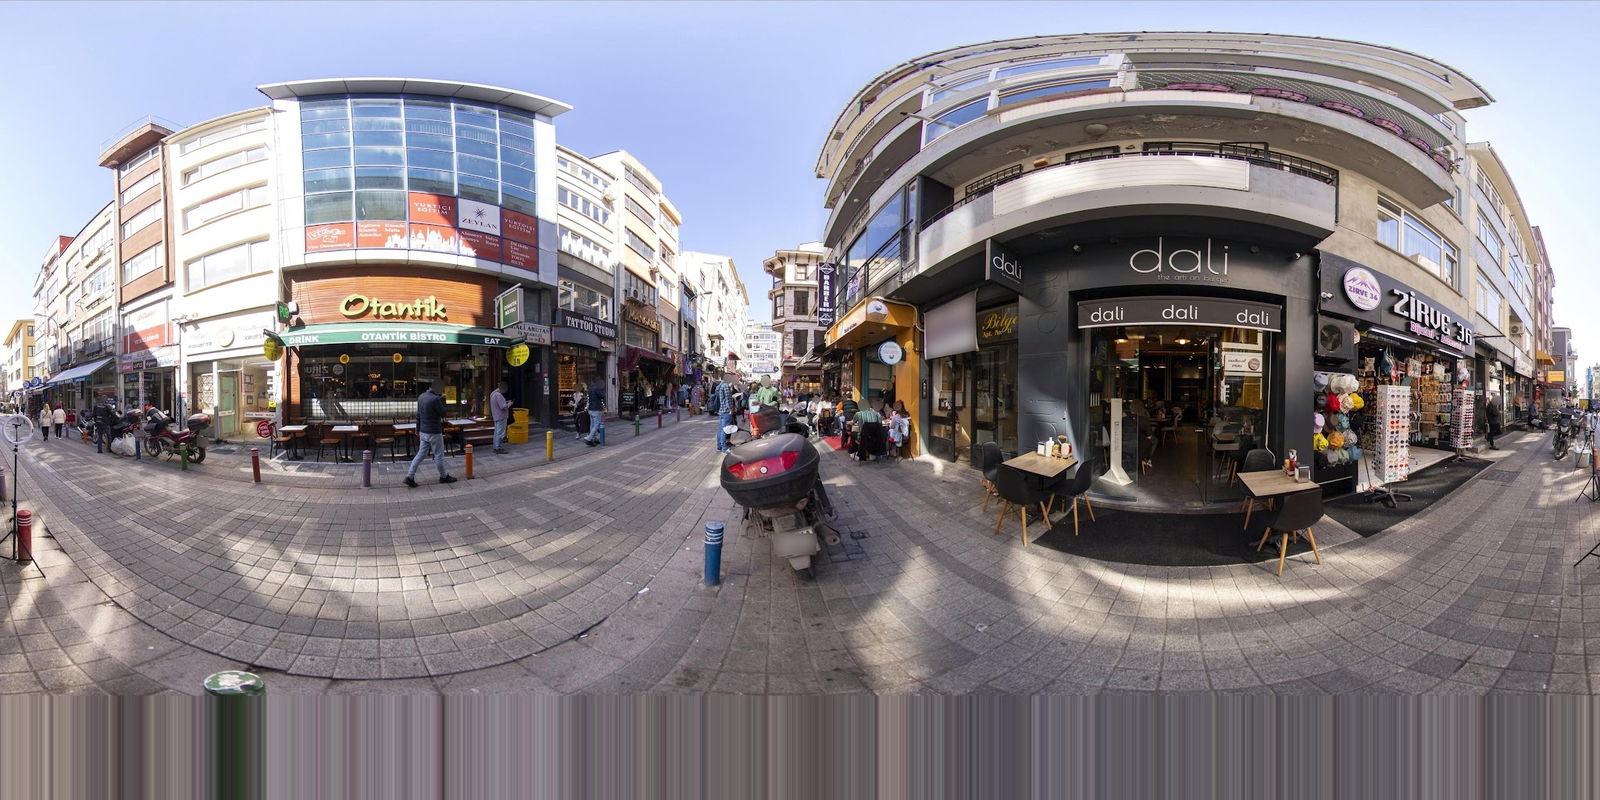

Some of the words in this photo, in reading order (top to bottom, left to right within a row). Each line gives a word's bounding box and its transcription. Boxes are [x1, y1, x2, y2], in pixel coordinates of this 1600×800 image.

[462, 218, 497, 230] ZEYLAN
[992, 253, 1022, 280] dali
[1129, 236, 1229, 275] dali
[339, 294, 447, 318] Otantik
[1369, 292, 1378, 301] 36
[982, 312, 1019, 333] Bilge
[1090, 306, 1124, 323] dali
[1161, 304, 1198, 320] dali
[1236, 309, 1269, 326] dali
[566, 316, 593, 332] TATTOO
[594, 323, 616, 338] STUDIO
[1456, 321, 1472, 346] 36
[361, 332, 407, 341] OTANTİK
[409, 332, 446, 341] BİSTRO
[484, 337, 500, 345] EAT
